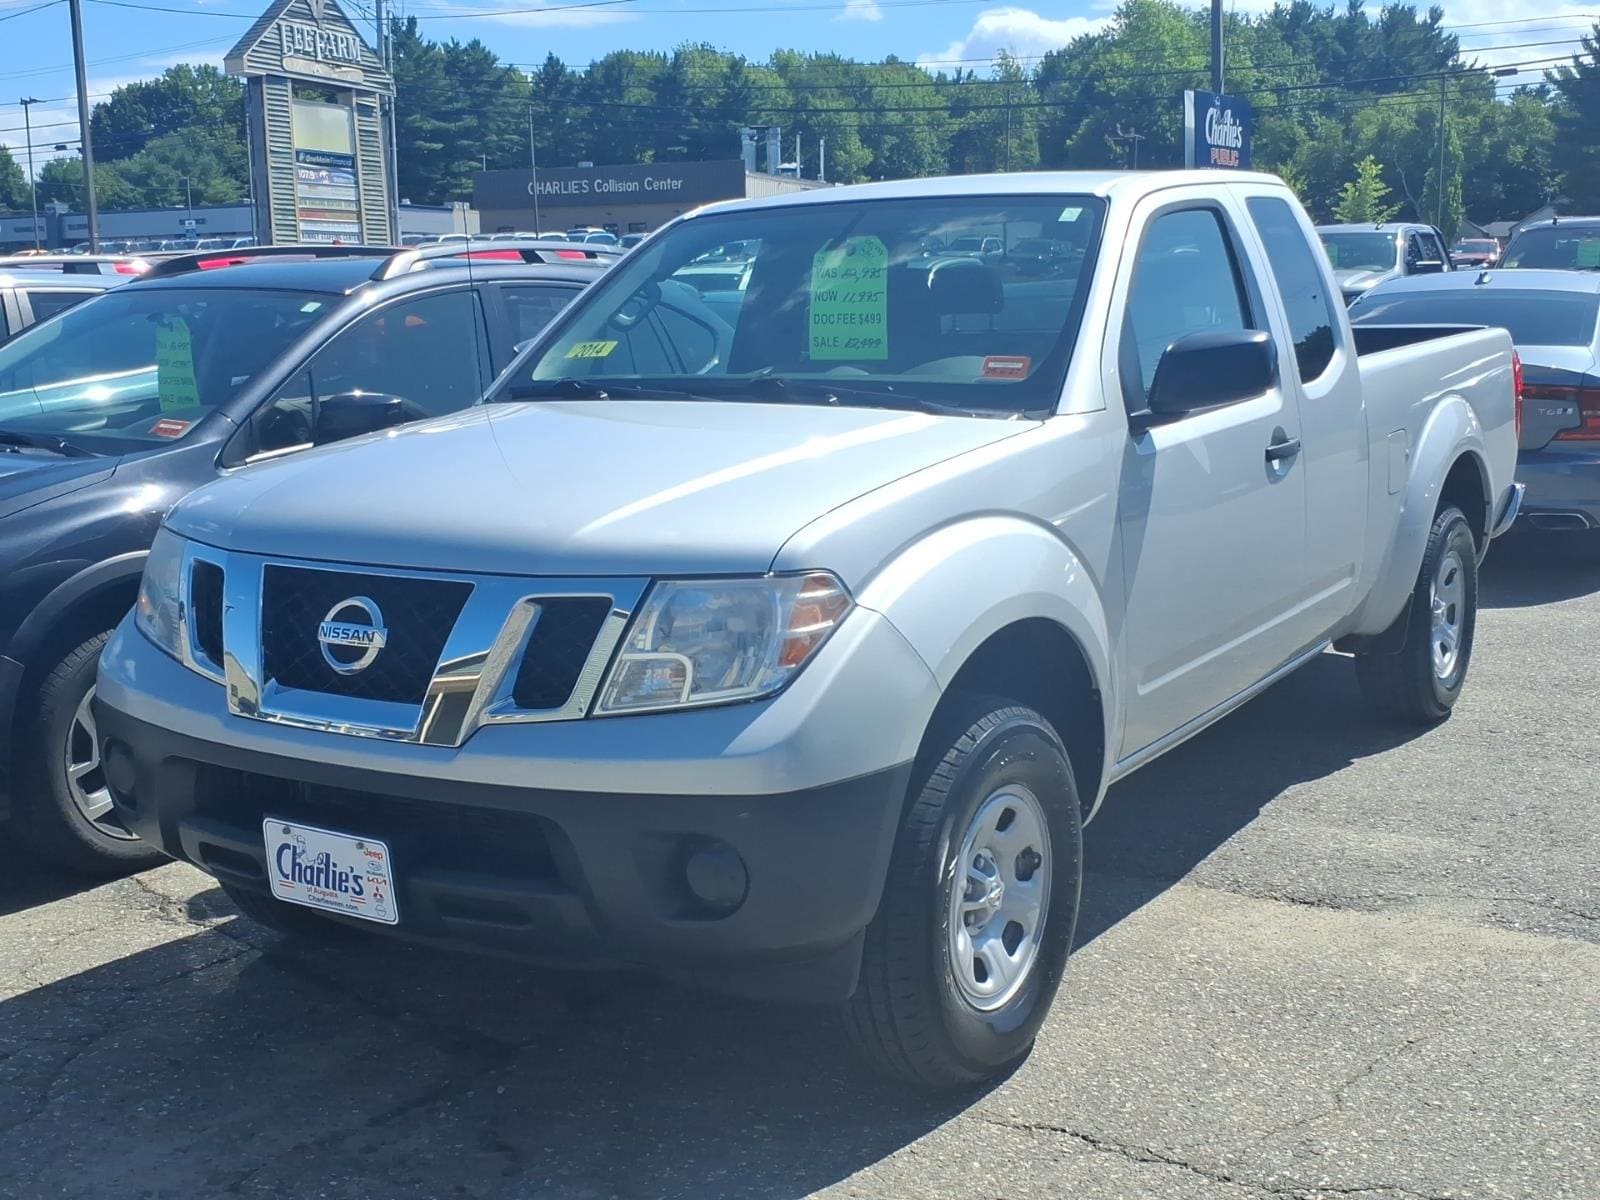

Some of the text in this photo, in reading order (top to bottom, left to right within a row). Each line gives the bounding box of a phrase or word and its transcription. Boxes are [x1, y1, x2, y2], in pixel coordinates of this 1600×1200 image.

[315, 29, 362, 62] FARM
[1206, 107, 1242, 149] Charlie's
[528, 177, 683, 195] CHARLIE'S Collision Center
[816, 267, 838, 279] WAS
[814, 290, 838, 303] NOW
[813, 312, 882, 325] DOC FEE $499
[813, 336, 839, 348] SALE
[574, 343, 608, 357] 2014
[320, 625, 375, 643] NISSAN
[363, 848, 383, 861] Jeep
[277, 842, 364, 896] Charlie's
